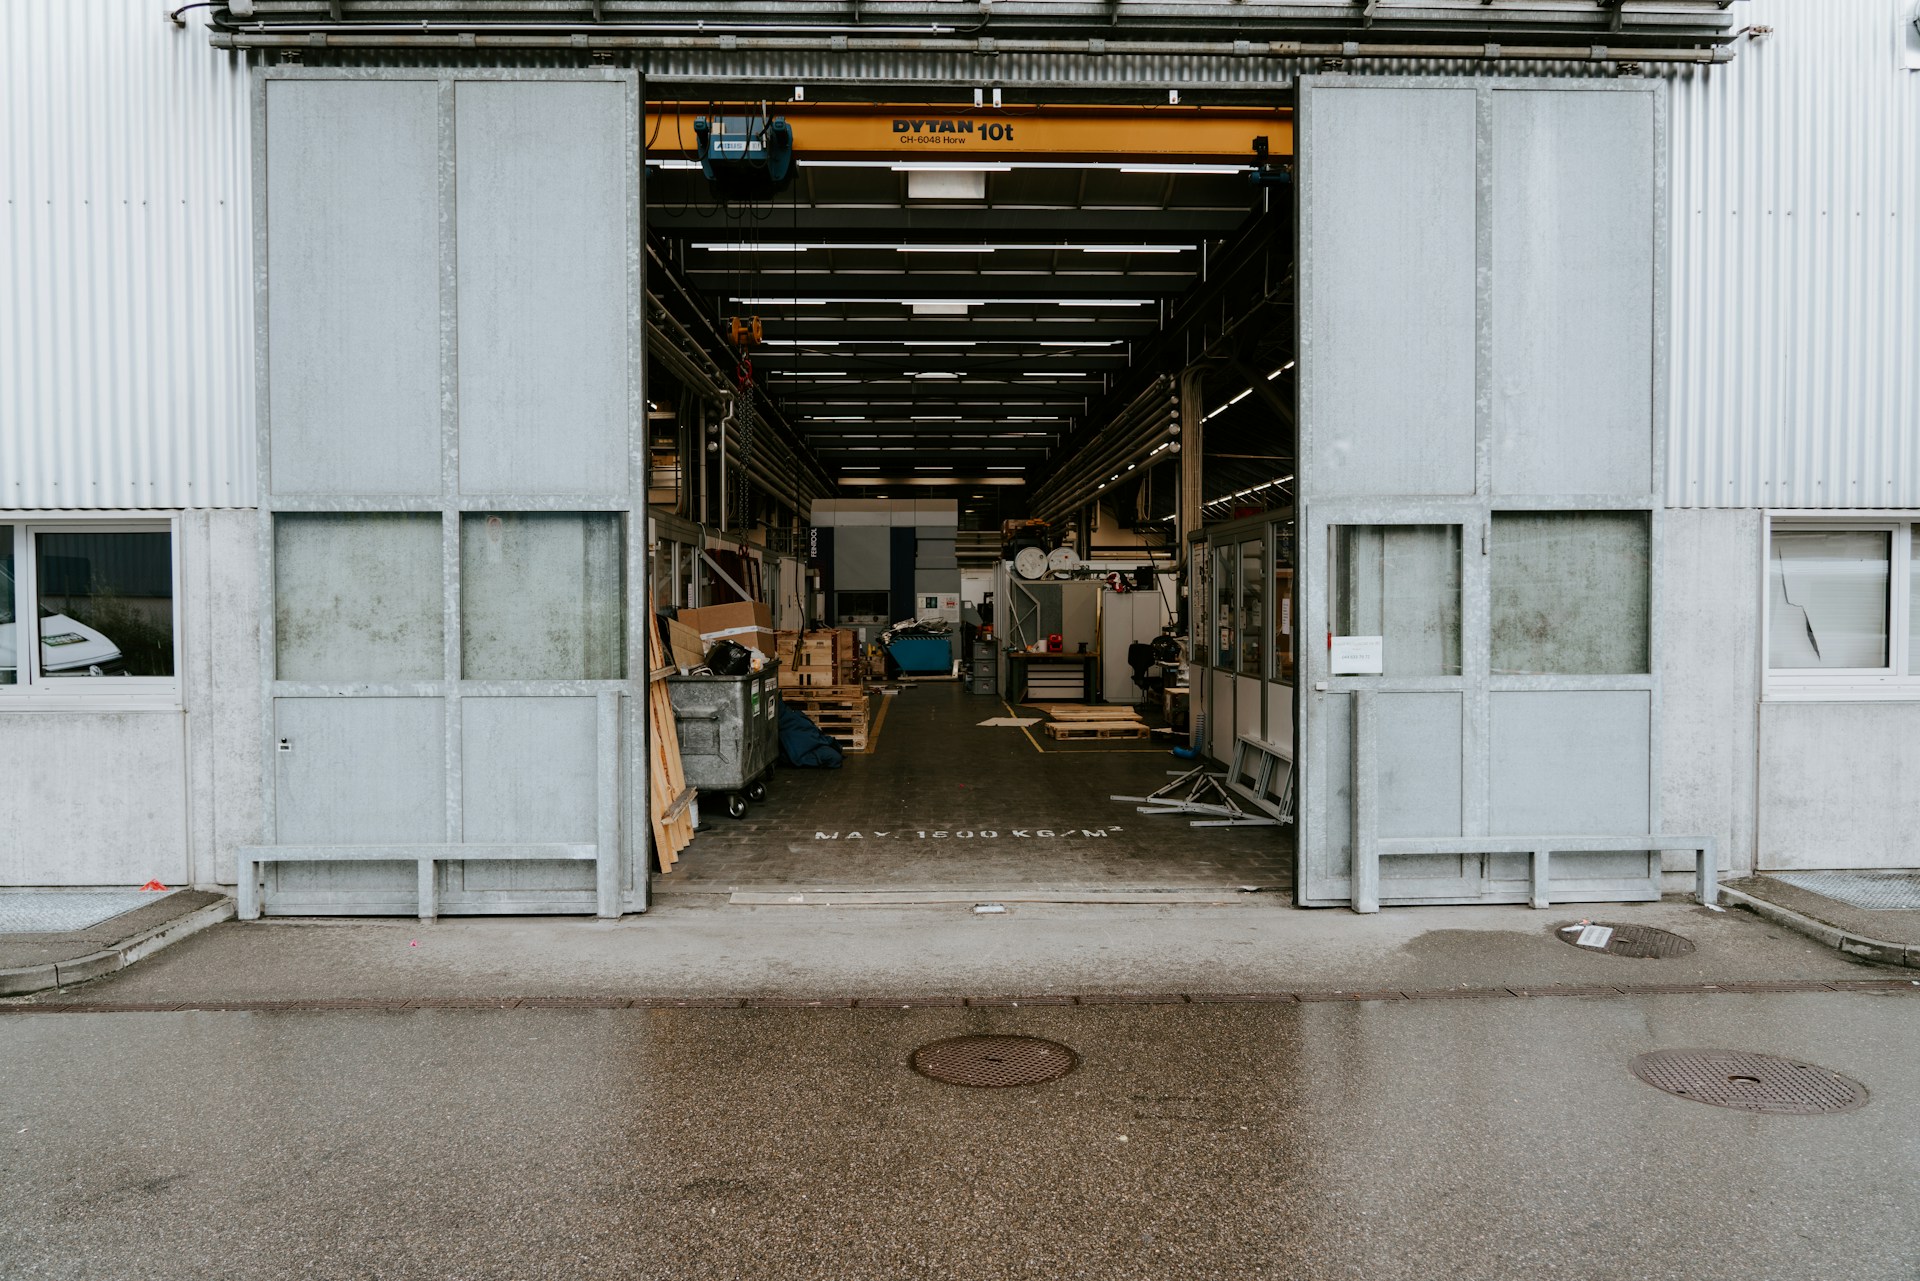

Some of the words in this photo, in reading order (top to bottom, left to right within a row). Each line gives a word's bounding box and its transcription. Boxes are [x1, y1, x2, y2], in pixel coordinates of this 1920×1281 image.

[892, 119, 974, 133] DYTAN
[977, 123, 1014, 141] 10t
[900, 136, 941, 144] CH-6048
[943, 136, 966, 144] Horw
[916, 830, 998, 839] 1500
